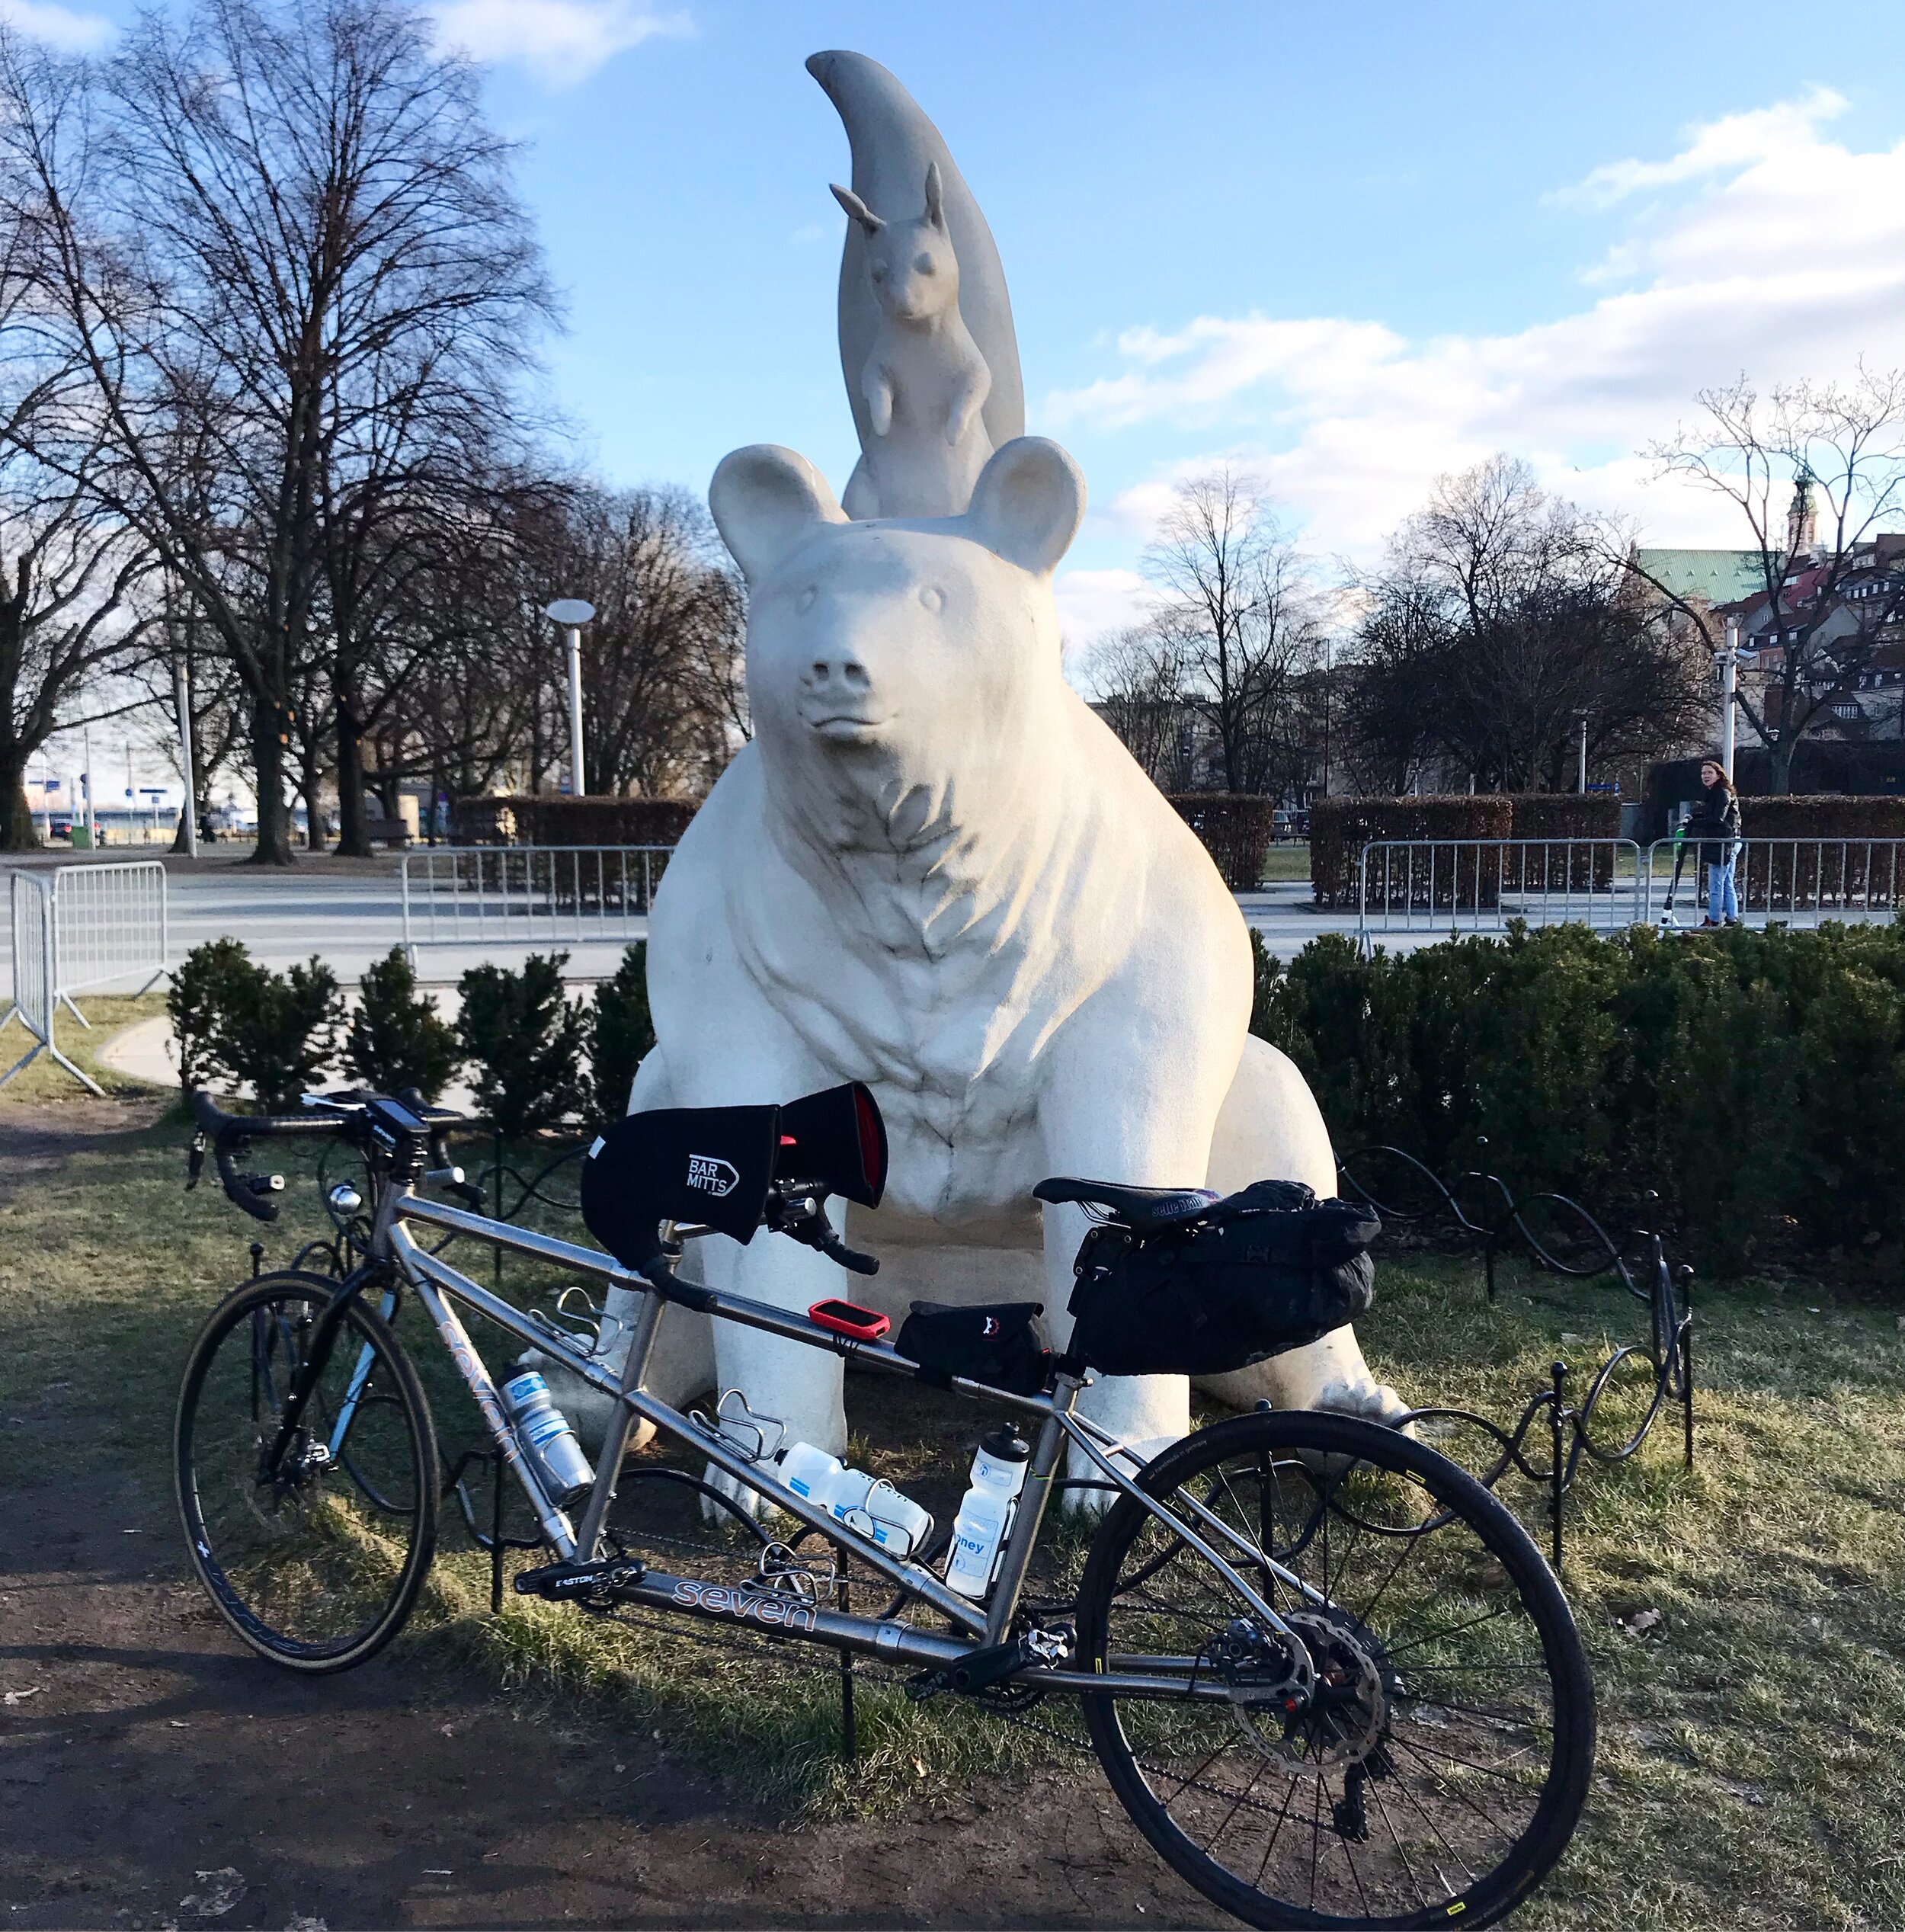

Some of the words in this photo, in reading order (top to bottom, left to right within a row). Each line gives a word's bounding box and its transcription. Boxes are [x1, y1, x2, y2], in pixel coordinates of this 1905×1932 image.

[688, 1159, 719, 1177] BAR
[687, 1173, 728, 1194] MITTS
[437, 1320, 520, 1463] seven
[555, 1575, 594, 1588] EASTON
[671, 1580, 818, 1632] seven
